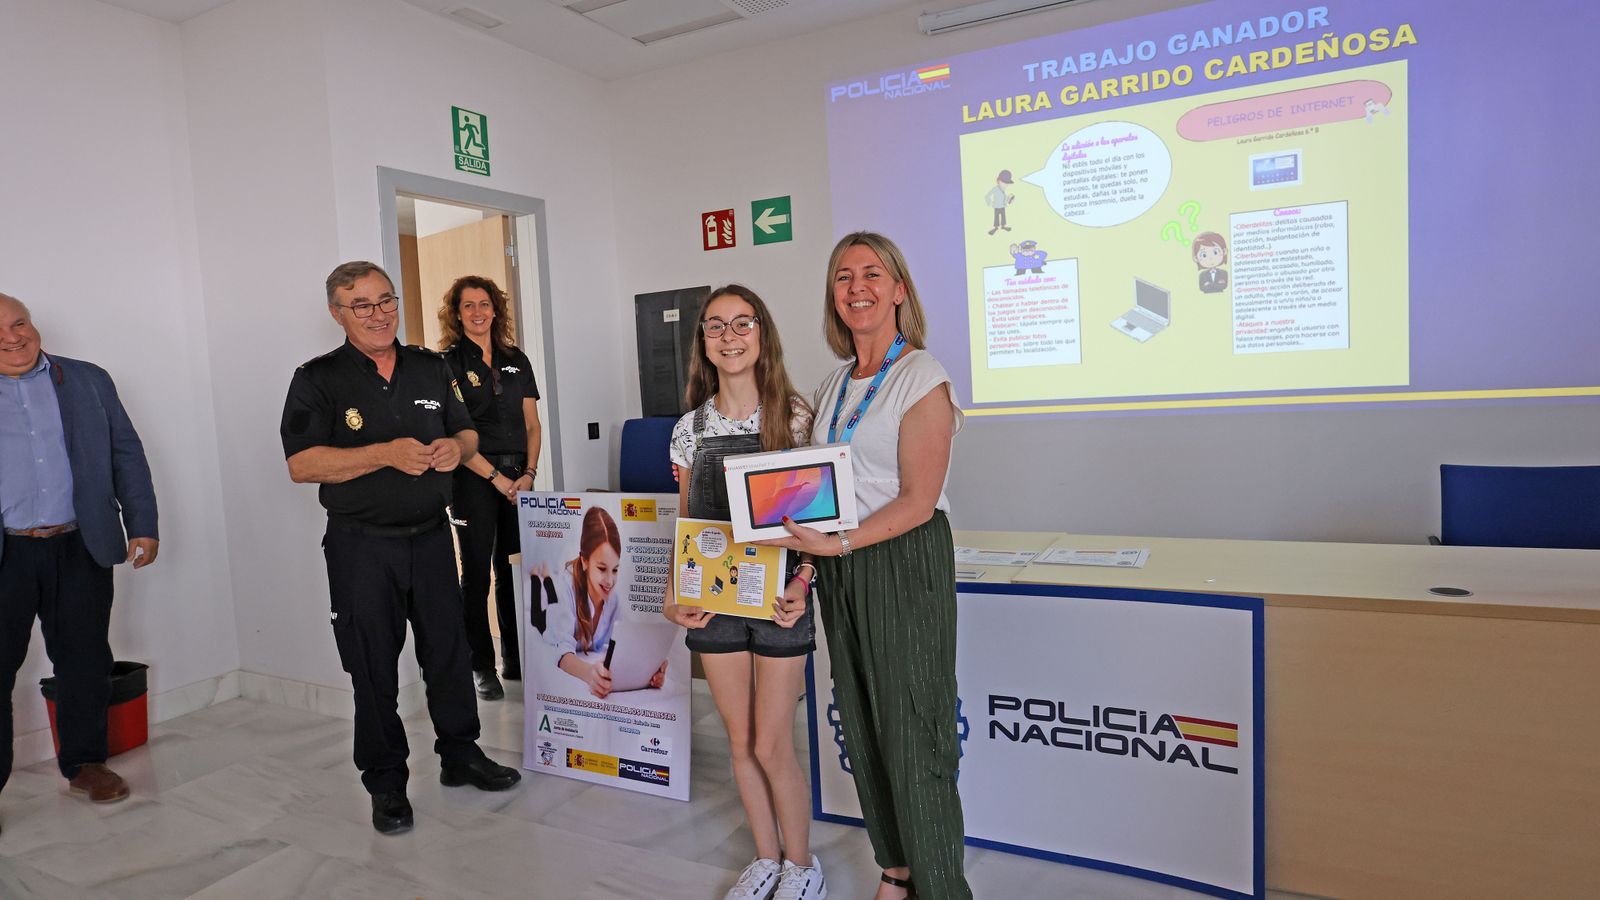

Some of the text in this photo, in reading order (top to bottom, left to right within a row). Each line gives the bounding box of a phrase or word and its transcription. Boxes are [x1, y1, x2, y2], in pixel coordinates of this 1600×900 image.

[1023, 6, 1330, 82] TRABAJO GANADOR
[962, 24, 1418, 124] LAURA GARRIDO CARDEÑOSA
[884, 82, 951, 100] NACIONAL
[1207, 96, 1355, 128] PELIGROS DE INTERNET
[1236, 136, 1252, 144] Laura
[1253, 134, 1274, 143] Garrido
[1275, 130, 1304, 140] Cardeñosa
[458, 156, 487, 170] SALIDA
[546, 521, 571, 529] ESCOLAR
[633, 546, 667, 554] CONCURSO
[635, 575, 662, 583] RIESGOS
[630, 585, 659, 593] INTERNET
[628, 594, 658, 603] ALUMNOS
[612, 705, 642, 716] TRABAJOS
[642, 709, 676, 721] FINALISTAS
[640, 745, 668, 756] Carrefour
[989, 720, 1238, 774] NACIONAL
[641, 774, 668, 782] NACIONAL
